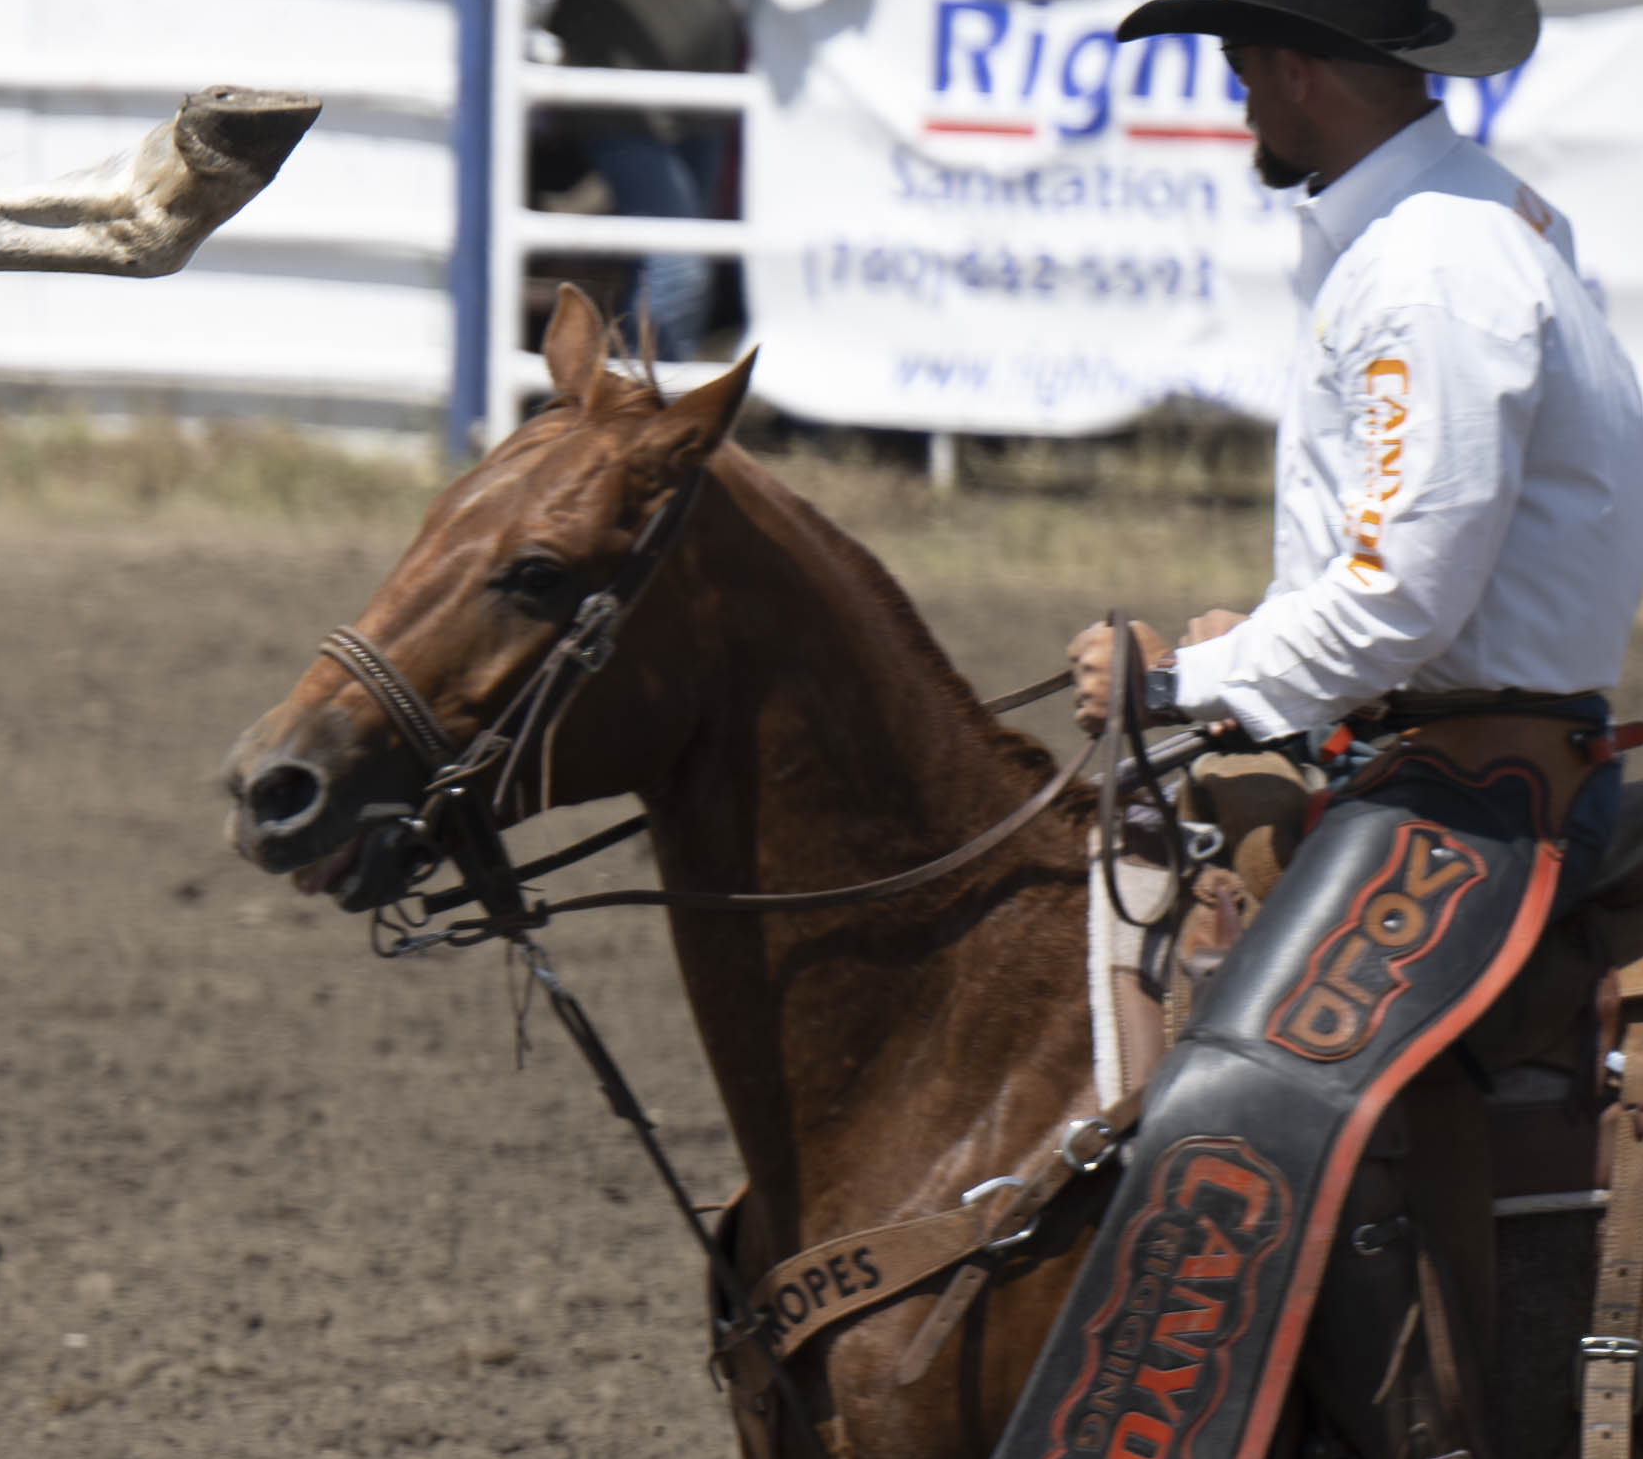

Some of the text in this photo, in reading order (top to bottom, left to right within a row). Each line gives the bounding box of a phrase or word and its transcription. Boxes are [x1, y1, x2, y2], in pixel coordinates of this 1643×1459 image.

[888, 142, 1217, 216] Sanitation
[1285, 834, 1468, 1048] VOLD
[1074, 1217, 1189, 1452] RIGGING
